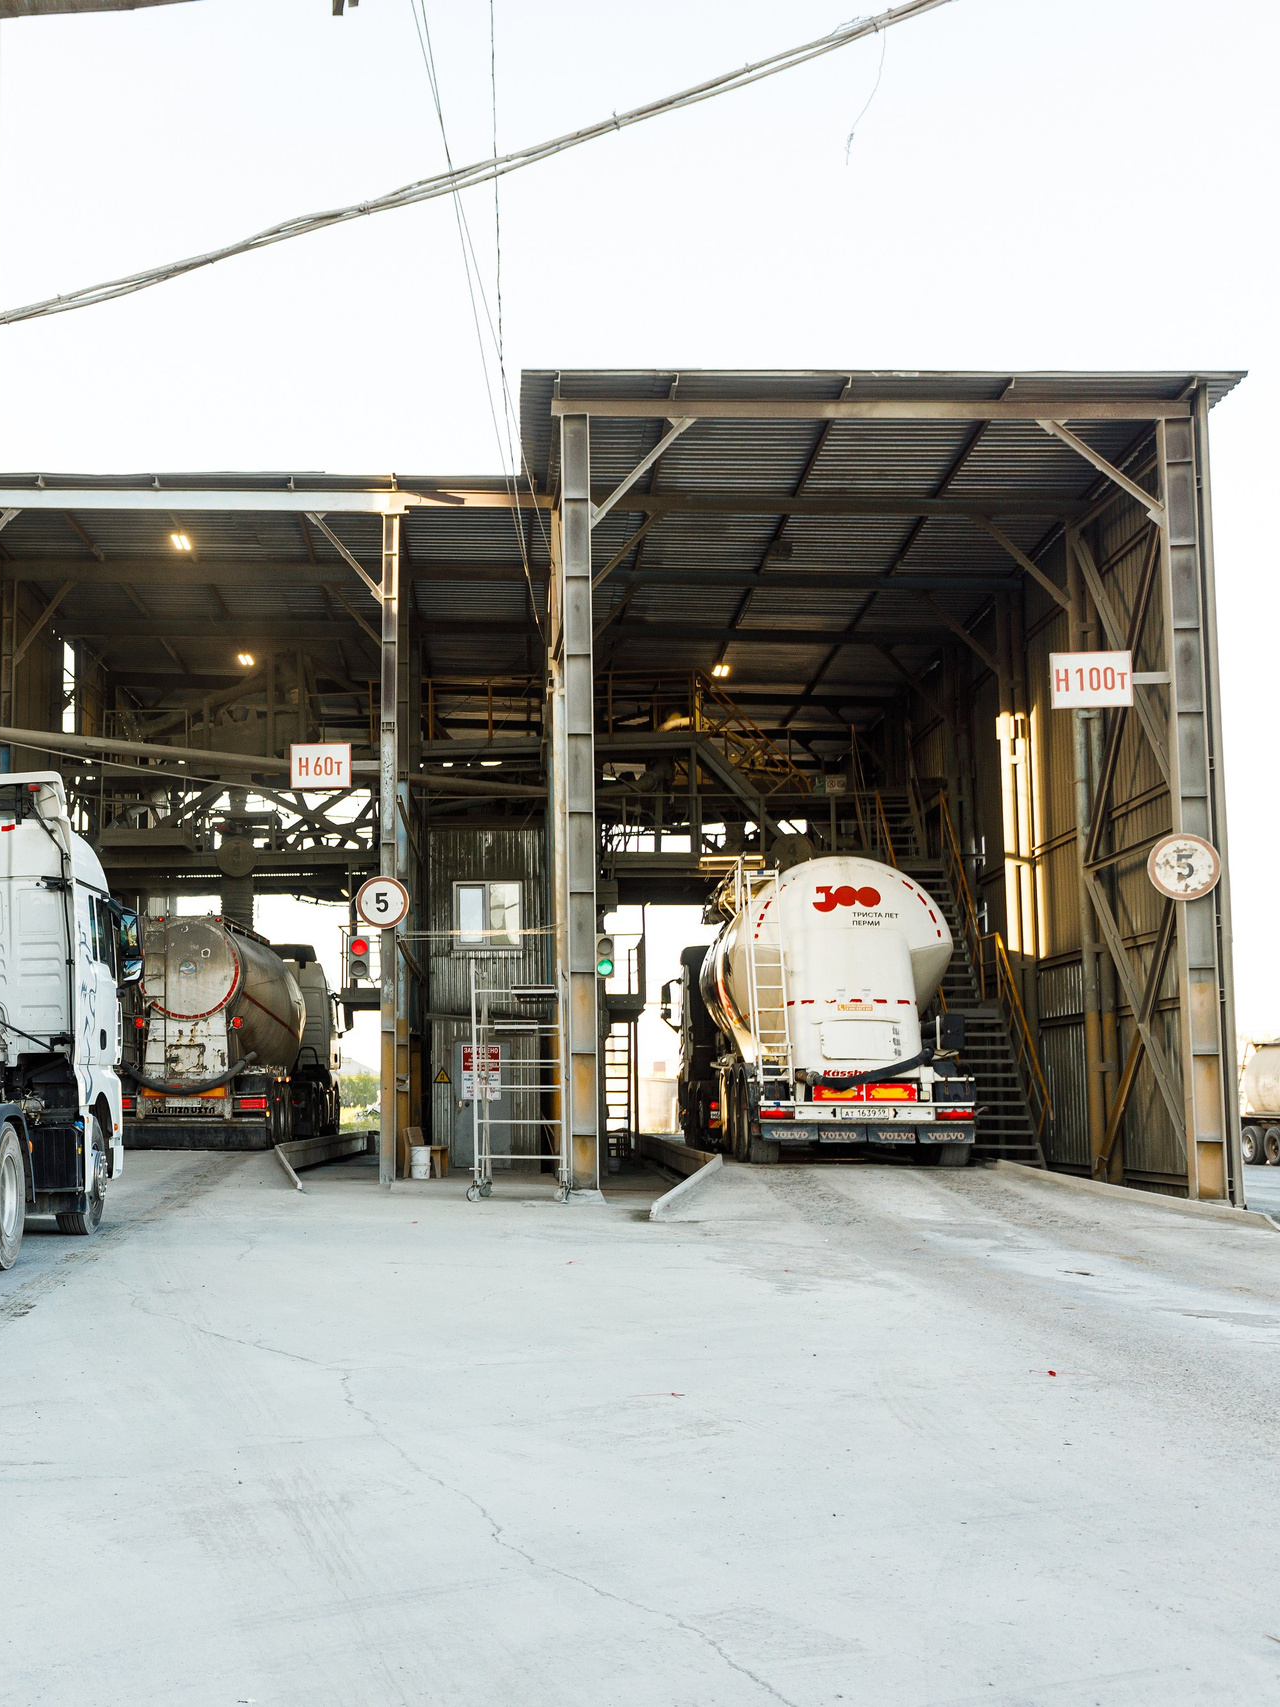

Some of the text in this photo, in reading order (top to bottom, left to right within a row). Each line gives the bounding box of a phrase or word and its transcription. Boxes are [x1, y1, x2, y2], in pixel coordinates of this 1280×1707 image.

[1176, 853, 1194, 879] 5
[375, 892, 389, 913] 5
[857, 1109, 877, 1117] 1639
[771, 1130, 809, 1139] VOLVO
[819, 1131, 857, 1140] VOLVO
[877, 1131, 916, 1140] VOLVO
[927, 1132, 965, 1141] VOLVO
